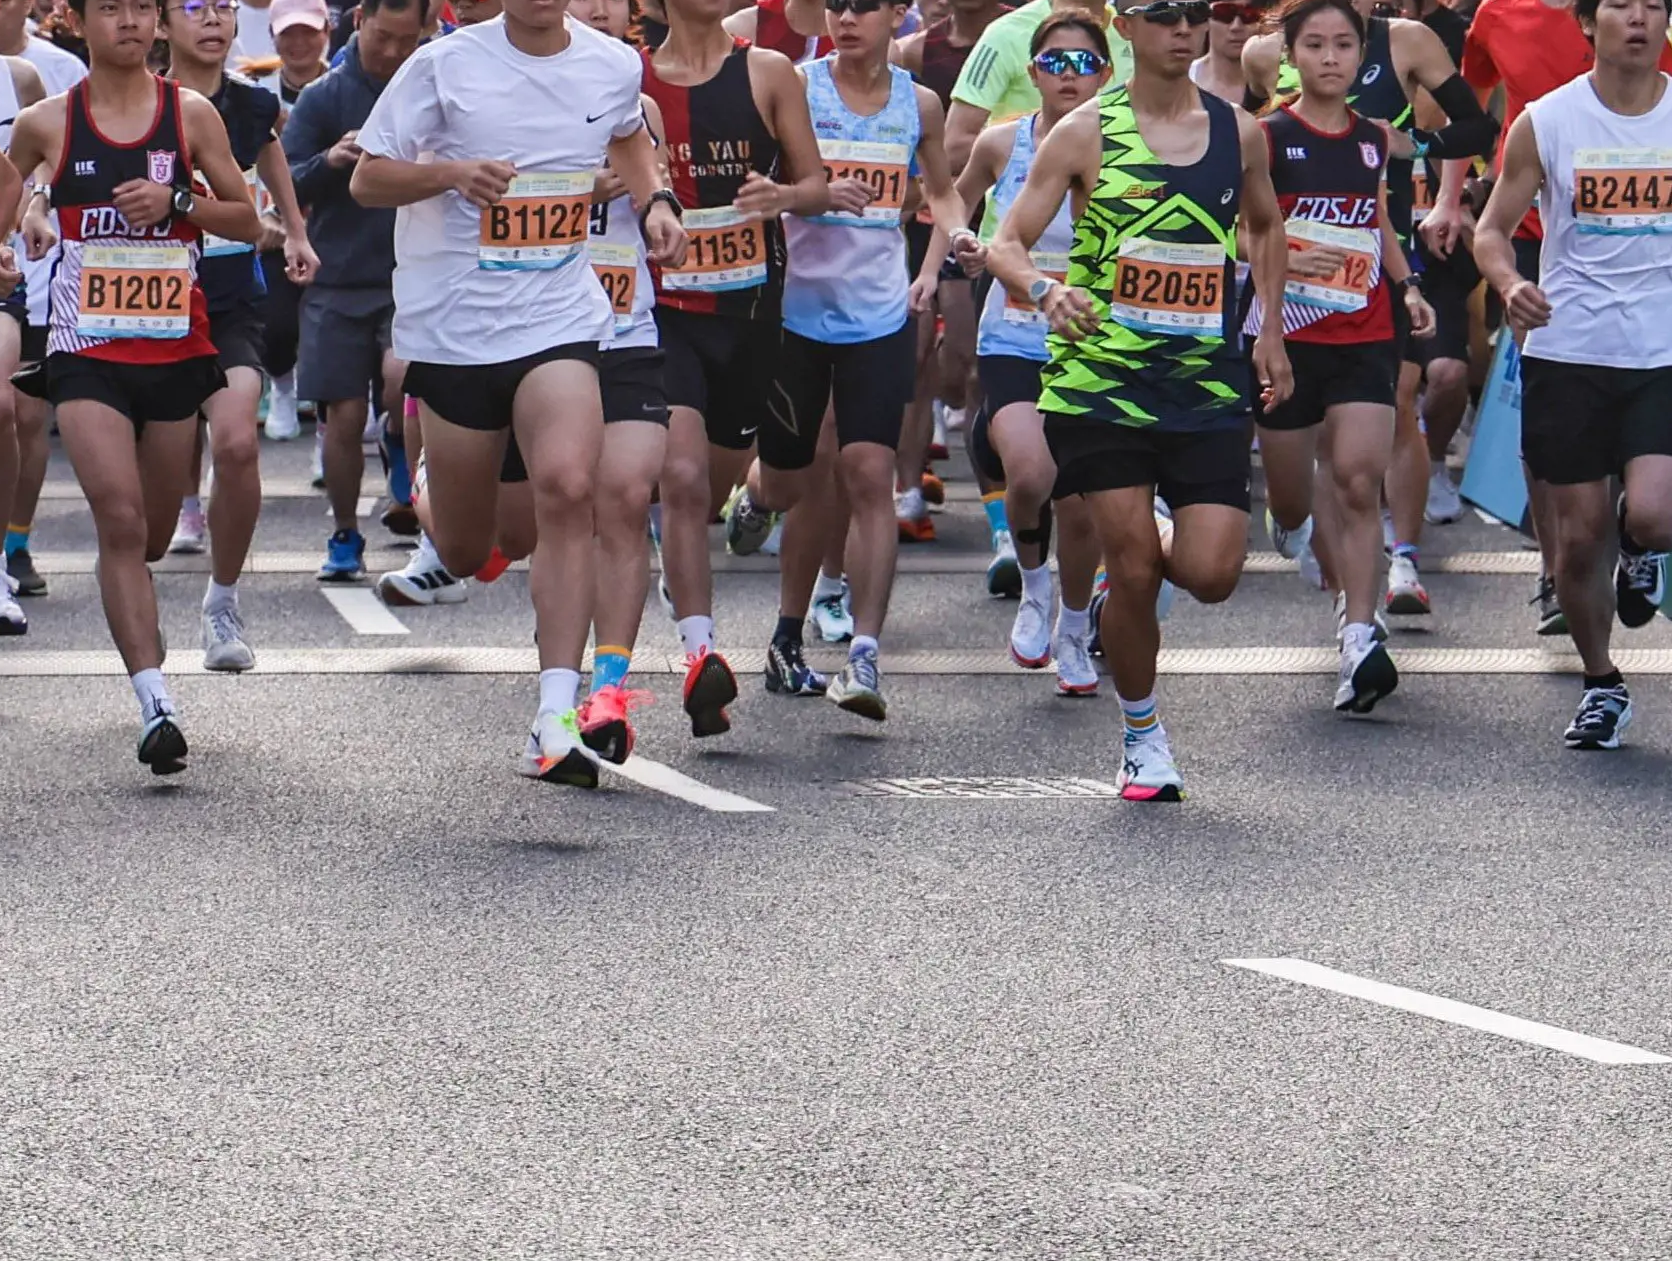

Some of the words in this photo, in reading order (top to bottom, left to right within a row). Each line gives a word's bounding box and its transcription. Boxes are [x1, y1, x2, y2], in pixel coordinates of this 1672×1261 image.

[709, 140, 750, 161] YAU
[490, 202, 584, 240] B1122
[690, 228, 756, 266] 1153
[87, 274, 182, 310] B1202
[1120, 264, 1217, 306] B2055
